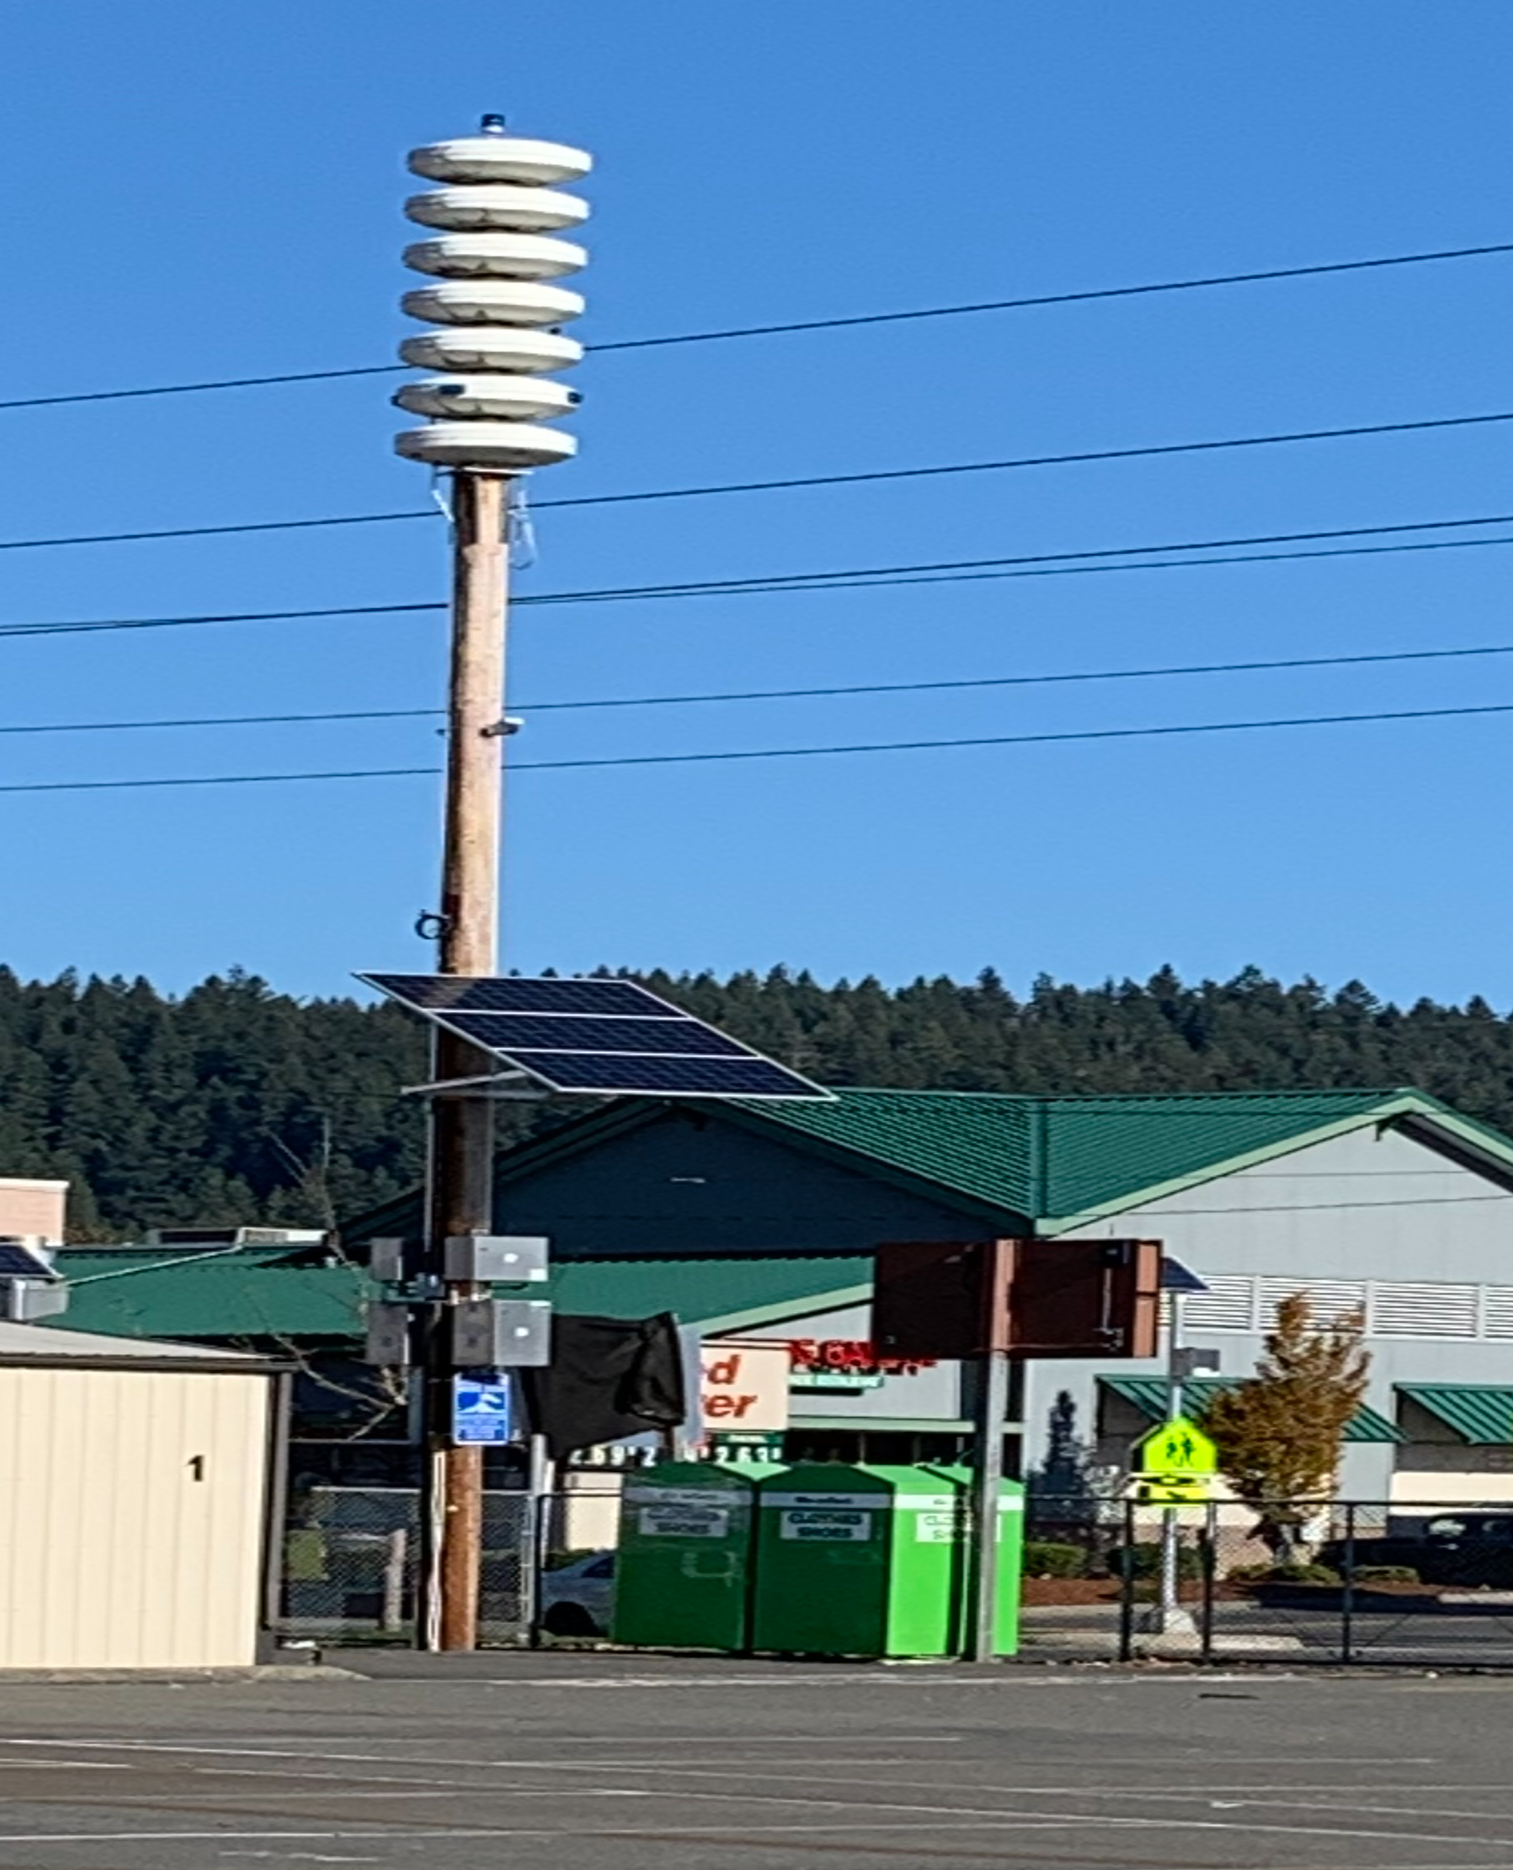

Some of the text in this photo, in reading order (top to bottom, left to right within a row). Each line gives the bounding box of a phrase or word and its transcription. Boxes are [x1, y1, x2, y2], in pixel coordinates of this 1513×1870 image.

[704, 1354, 740, 1384] d
[703, 1394, 757, 1418] er
[187, 1454, 204, 1482] 1
